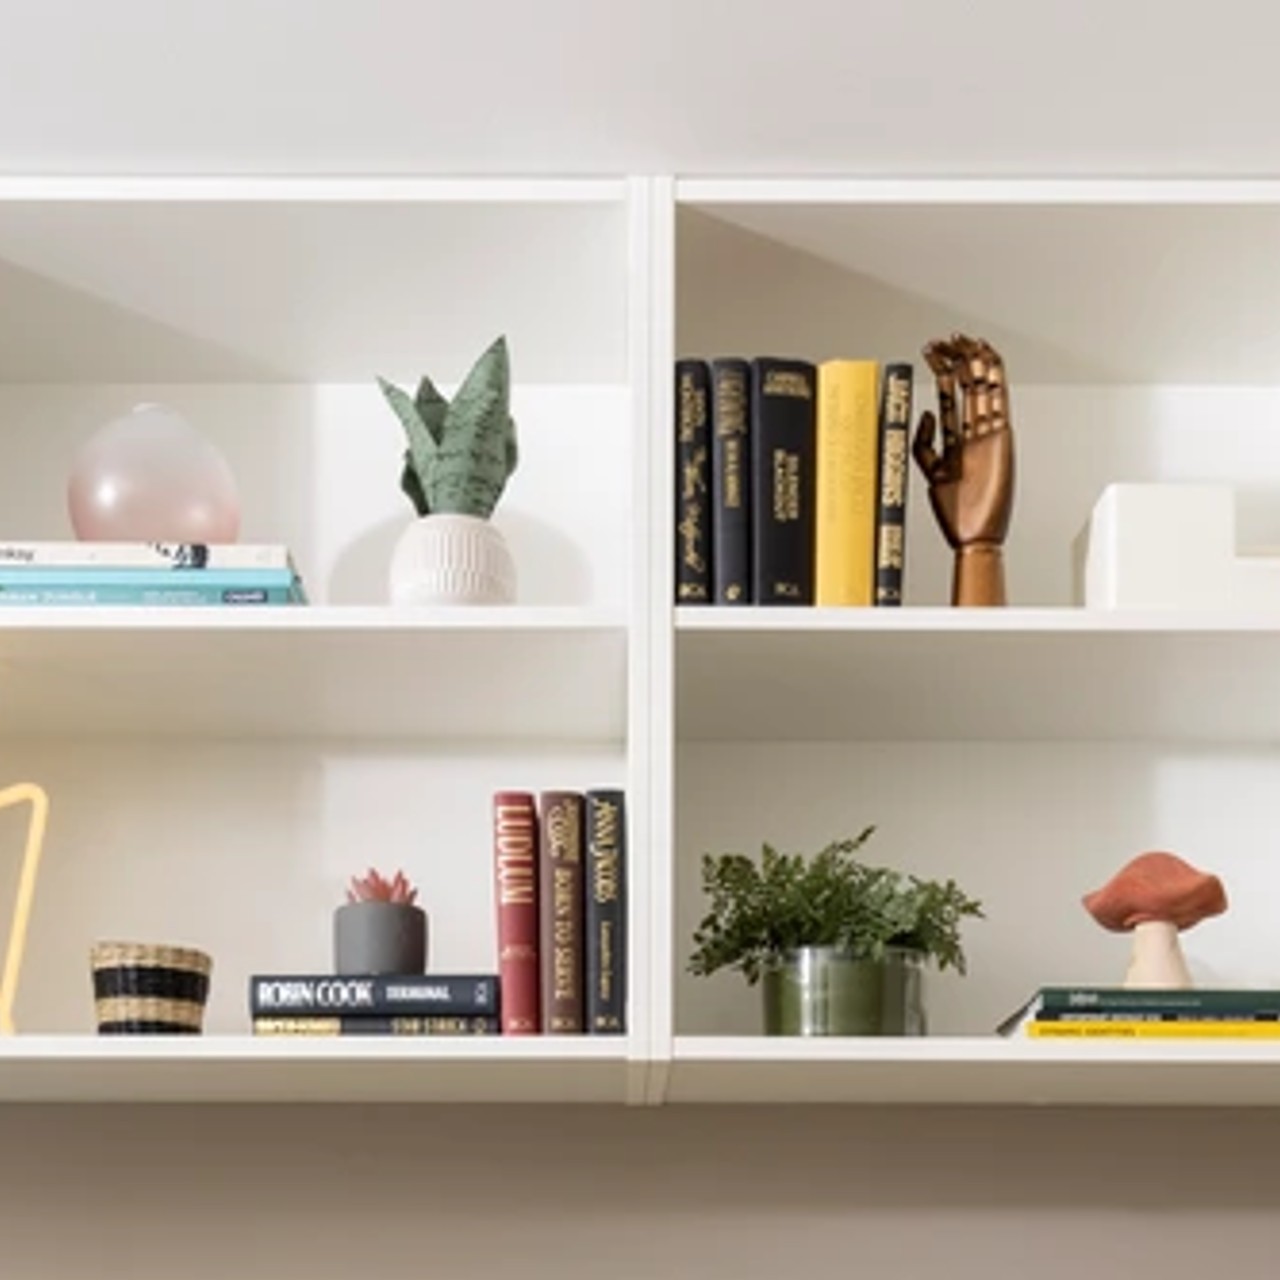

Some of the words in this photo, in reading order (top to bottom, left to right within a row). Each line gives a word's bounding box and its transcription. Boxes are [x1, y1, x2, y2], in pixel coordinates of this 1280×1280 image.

[885, 372, 910, 425] JACK
[881, 428, 908, 508] HIGGINS
[497, 804, 534, 905] LUDLUM
[554, 868, 575, 916] BORN
[554, 921, 575, 943] TO
[257, 981, 315, 1008] ROBIN
[316, 981, 375, 1008] COOK
[385, 985, 451, 1002] TERMINAL
[554, 947, 575, 999] SERVE
